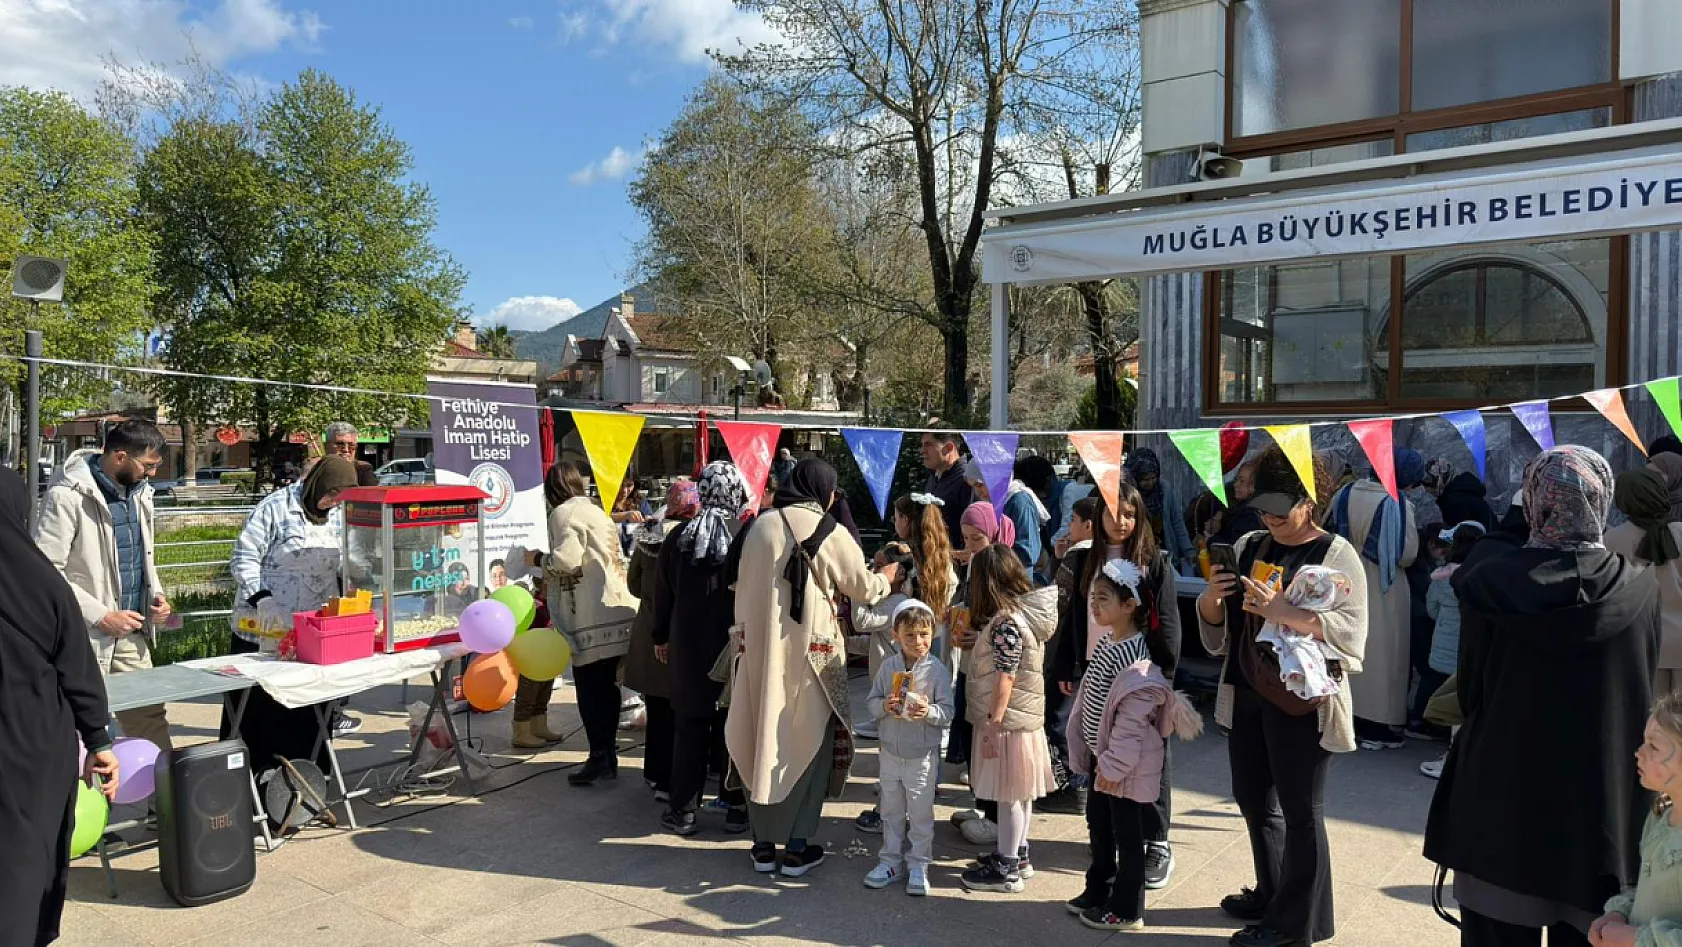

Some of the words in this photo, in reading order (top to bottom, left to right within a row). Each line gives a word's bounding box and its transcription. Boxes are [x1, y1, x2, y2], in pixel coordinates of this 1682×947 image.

[1143, 225, 1247, 255] MUĞLA
[1257, 199, 1477, 244] BÜYÜKŞEHİR
[1489, 178, 1682, 222] BELEDİYE
[441, 398, 498, 417] Fethiye
[453, 414, 516, 430] Anadolu
[444, 425, 487, 444] İmam
[491, 430, 530, 447] Hatip
[470, 445, 511, 461] Lisesi
[210, 815, 232, 829] JBL
